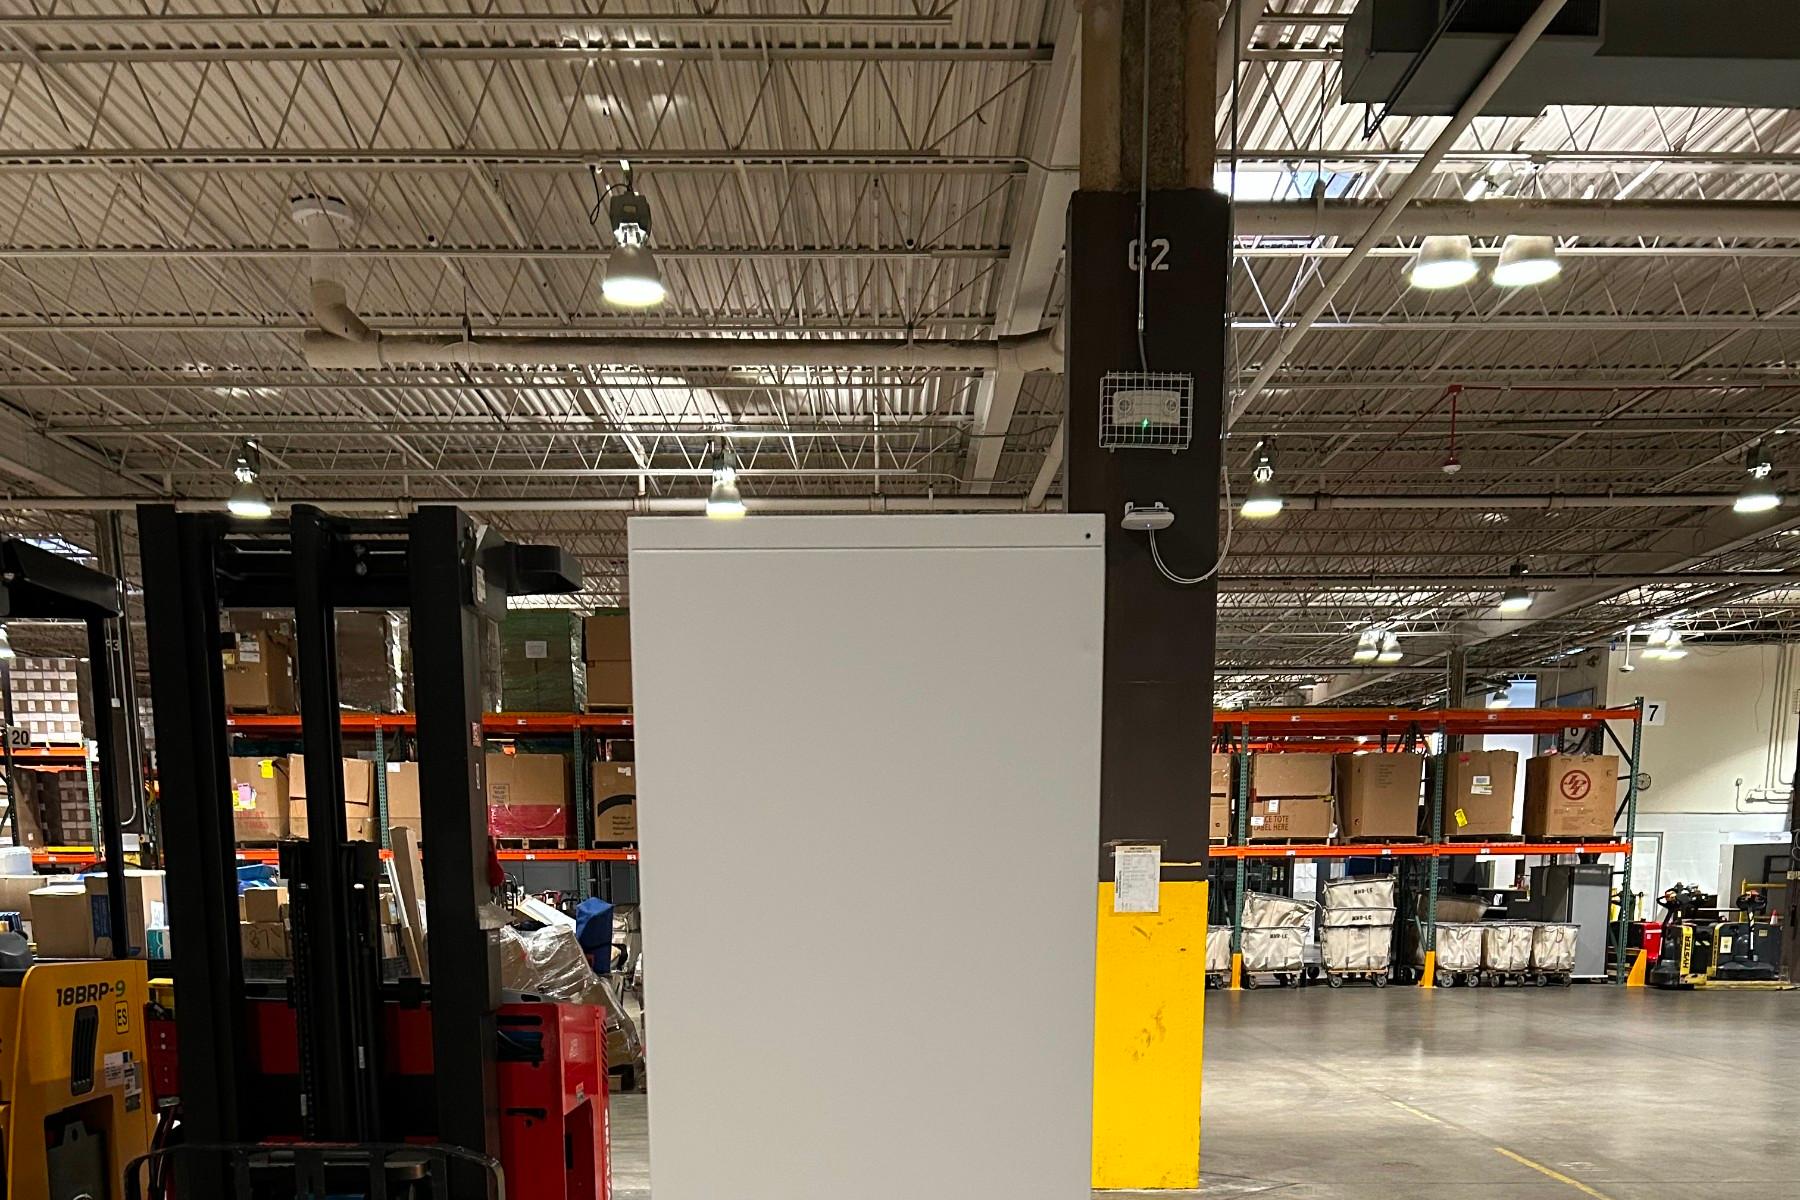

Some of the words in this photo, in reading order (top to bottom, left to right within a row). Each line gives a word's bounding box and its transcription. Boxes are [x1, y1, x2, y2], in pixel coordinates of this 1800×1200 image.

[1649, 705, 1659, 721] 7
[12, 730, 29, 745] 20
[1683, 936, 1691, 968] HYSTER
[57, 980, 125, 1007] 18BRP-9
[117, 1008, 127, 1026] ES
